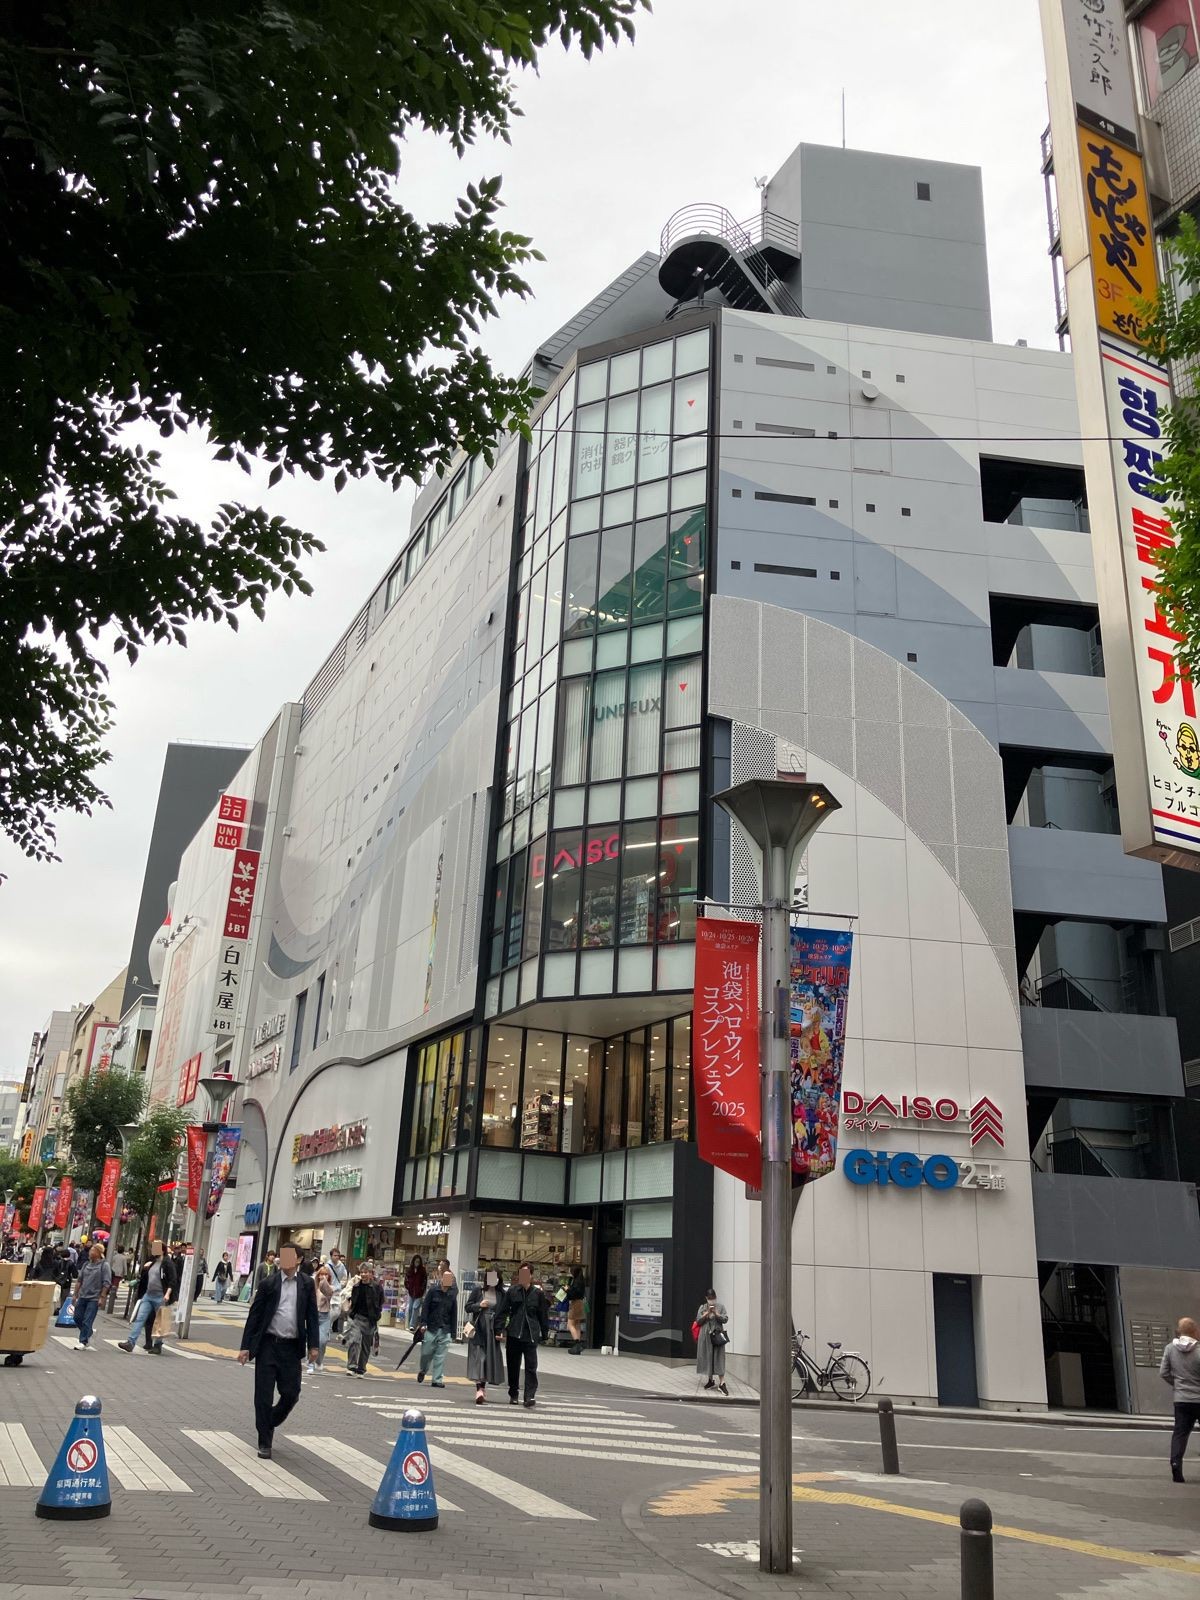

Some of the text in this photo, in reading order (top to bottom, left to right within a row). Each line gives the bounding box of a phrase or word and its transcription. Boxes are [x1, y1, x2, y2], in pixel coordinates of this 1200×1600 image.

[1098, 277, 1124, 303] 3F
[217, 834, 238, 847] QLO
[219, 825, 237, 837] UNI
[234, 922, 245, 934] B1
[215, 945, 240, 1010] 白木屋
[219, 1020, 231, 1030] B1
[721, 960, 745, 1078] 池袋ハロウィン
[700, 985, 725, 1098] コスプレフェス
[712, 1101, 746, 1117] 2025
[843, 1091, 959, 1122] DAISO
[845, 1118, 890, 1132] ダイソー
[843, 1148, 959, 1190] GiGO
[960, 1160, 1006, 1191] 2号館
